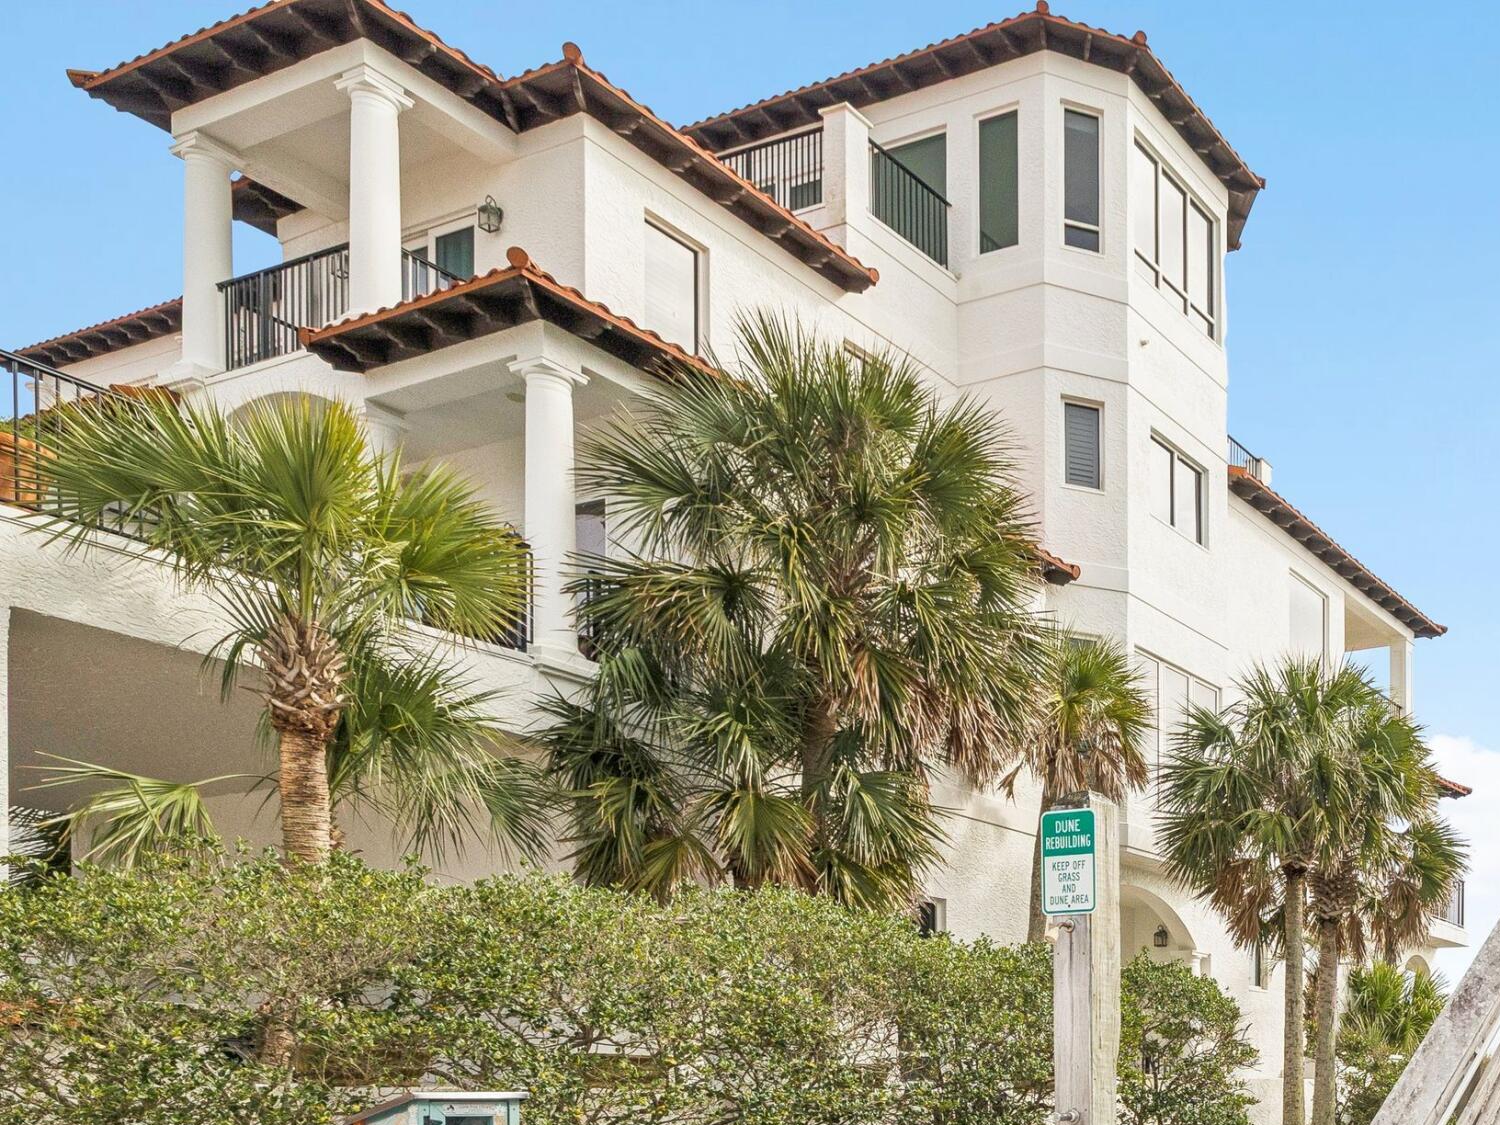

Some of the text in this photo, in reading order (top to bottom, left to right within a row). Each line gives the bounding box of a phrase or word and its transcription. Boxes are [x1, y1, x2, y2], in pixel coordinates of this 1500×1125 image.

[1055, 819, 1081, 833] DUNE
[1045, 834, 1091, 850] REBUILDING
[1052, 860, 1086, 871] KEEP OFF
[1058, 872, 1080, 882] GRASS
[1062, 884, 1076, 893] AND
[1050, 894, 1089, 905] DUNE AREA
